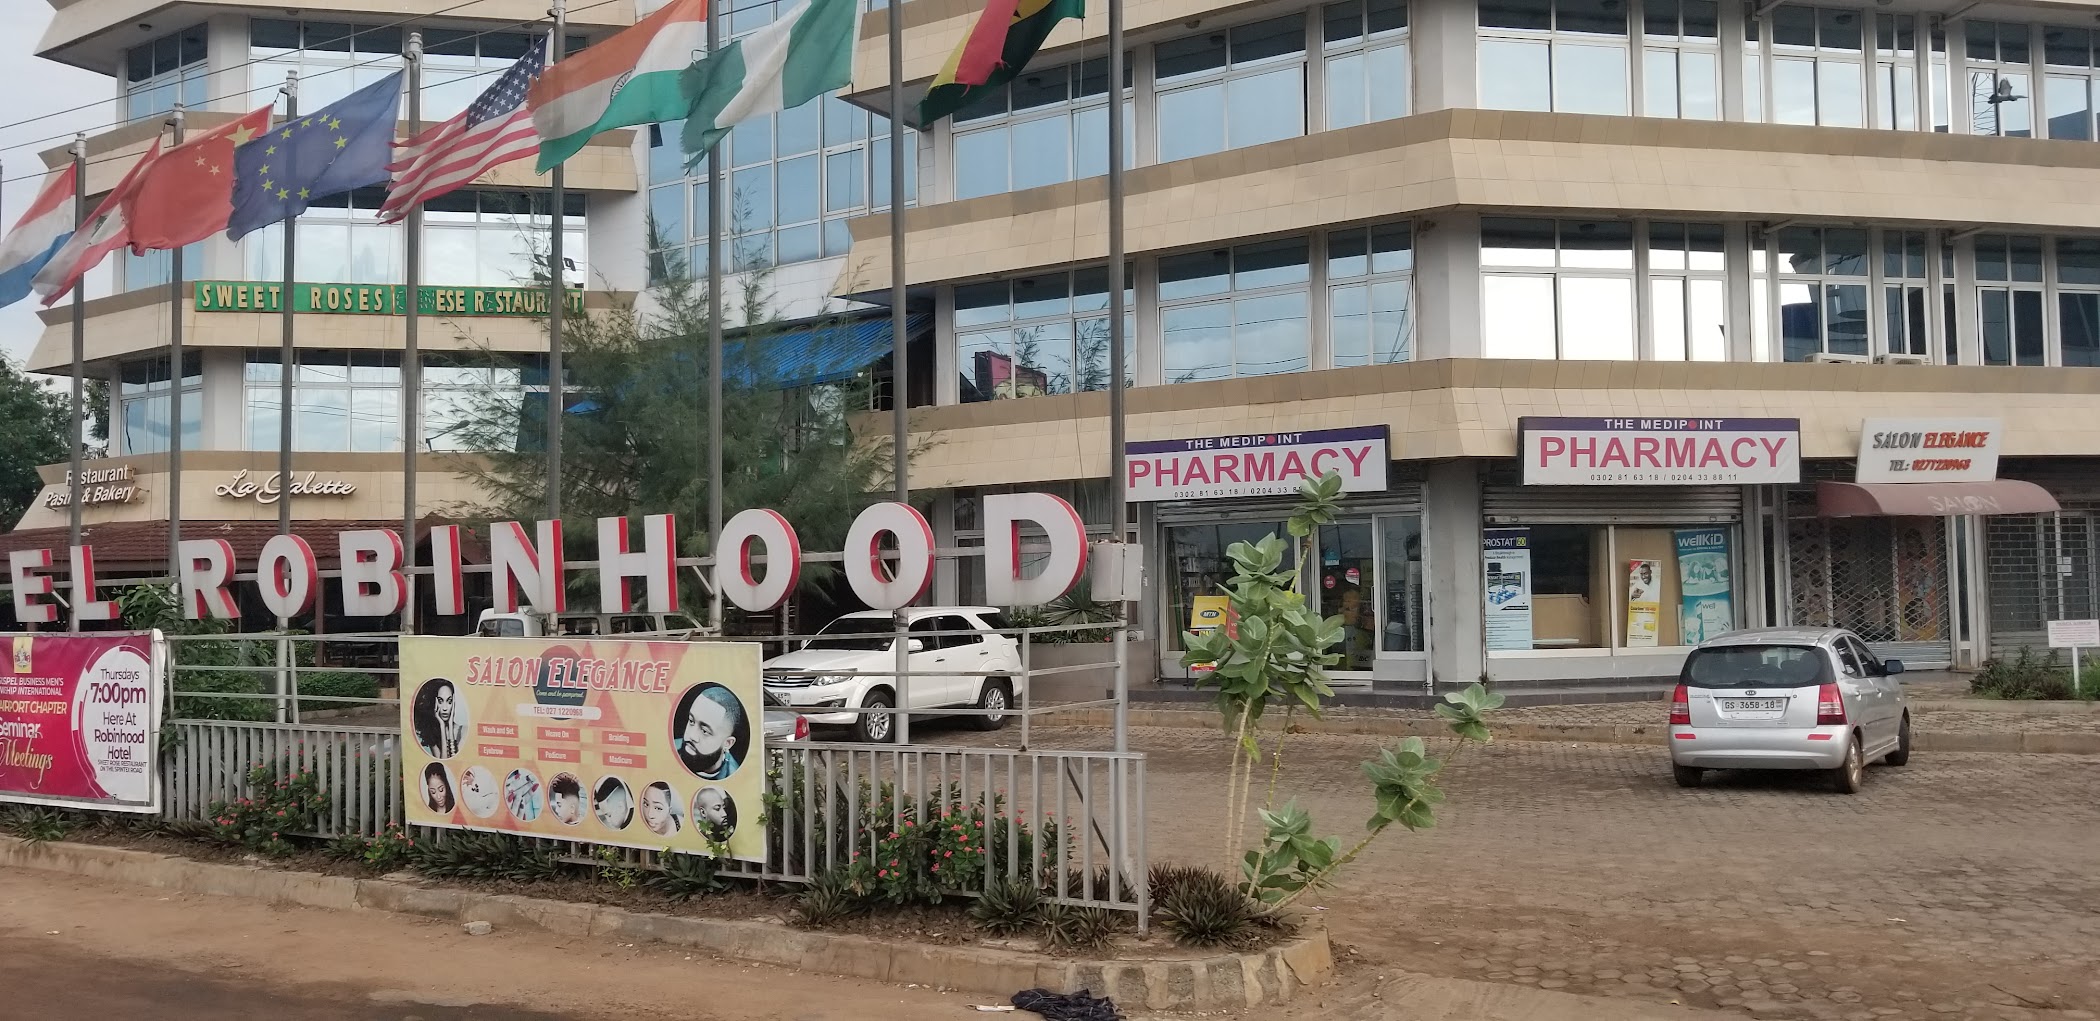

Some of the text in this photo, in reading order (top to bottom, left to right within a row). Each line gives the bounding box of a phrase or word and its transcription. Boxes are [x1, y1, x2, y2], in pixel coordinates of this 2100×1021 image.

[202, 284, 280, 309] SWEET
[311, 287, 383, 311] ROSES
[1604, 419, 1634, 429] THE
[1186, 438, 1213, 450] THE
[1873, 430, 1990, 449] SALON ELEGANCE
[1540, 437, 1787, 468] PHARMACY
[1128, 445, 1372, 489] PHARMACY
[1889, 459, 1910, 471] TEL:
[65, 464, 129, 487] Rstaurant
[215, 468, 259, 498] La
[1590, 473, 1613, 481] 0302
[1618, 473, 1628, 481] 81
[1633, 473, 1644, 481] 63
[1649, 473, 1659, 481] 18
[1671, 473, 1693, 481] 0204
[1698, 473, 1708, 481] 33
[1713, 473, 1723, 481] 88
[1728, 473, 1738, 481] 11
[81, 487, 91, 503] &
[93, 485, 136, 503] Bakery
[1229, 488, 1239, 496] 18
[1251, 487, 1273, 495] 0204
[1483, 537, 1514, 547] PROSTAT
[178, 493, 1089, 620] ROBINHOOD
[101, 668, 140, 683] Thursdays
[466, 655, 672, 693] SALON ELEGANCE
[19, 677, 45, 686] BUSINESS
[46, 677, 64, 687] MEN'S
[18, 687, 63, 696] INTERNATIONAL
[91, 682, 147, 709] 7:00pm
[30, 701, 68, 715] CHAPTER
[534, 706, 545, 715] TEL:
[546, 707, 557, 715] 027
[1725, 701, 1735, 709] GS
[103, 711, 137, 726] Here At
[0, 717, 41, 739] Seminar
[94, 728, 145, 744] Robinhood
[108, 745, 132, 760] Hotel
[0, 735, 53, 789] Meetings
